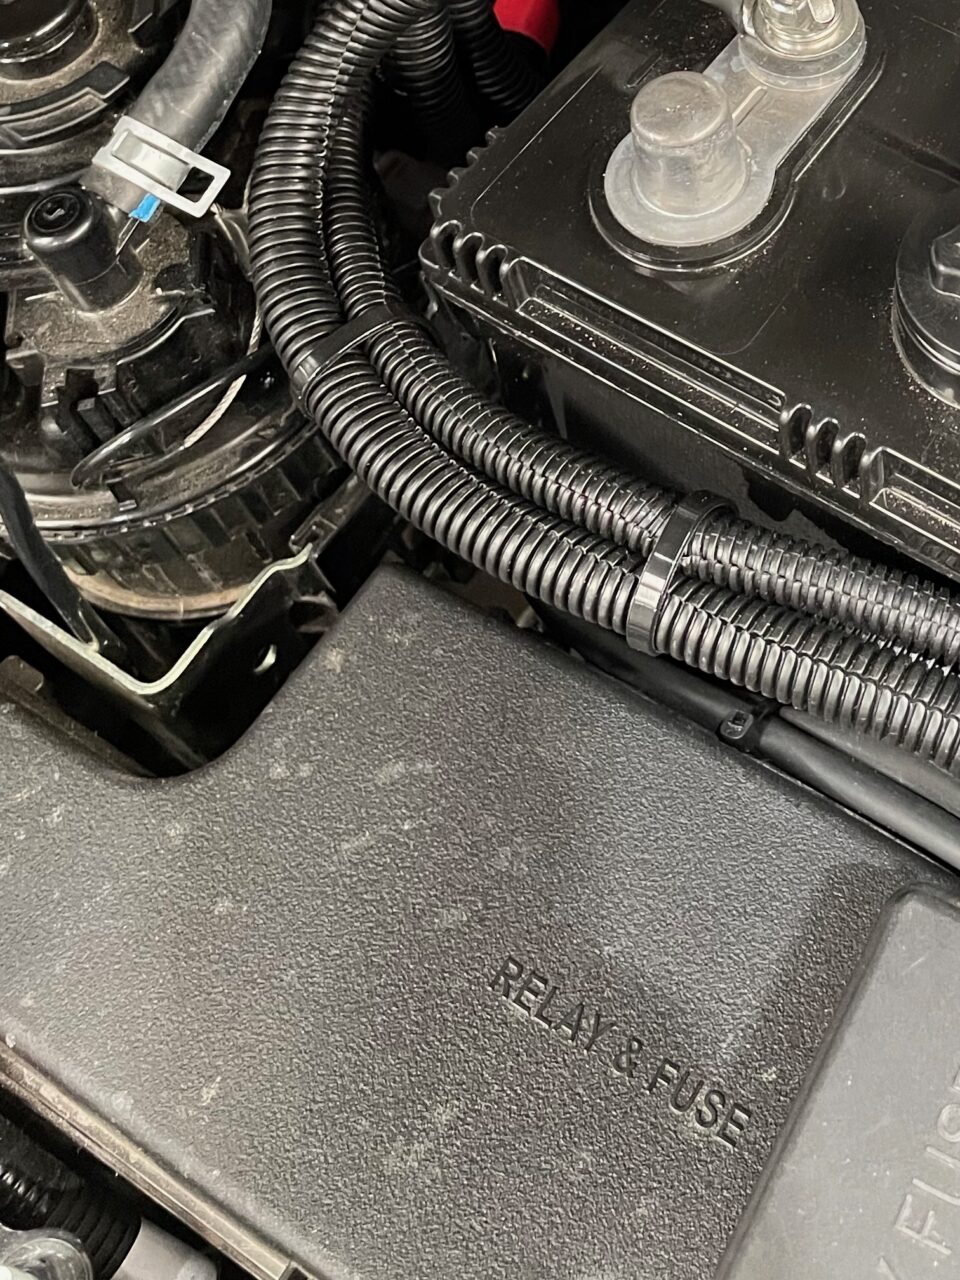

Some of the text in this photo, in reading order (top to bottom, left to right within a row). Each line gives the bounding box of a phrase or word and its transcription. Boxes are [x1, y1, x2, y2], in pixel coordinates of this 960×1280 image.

[489, 955, 752, 1148] RELAY & FUSE
